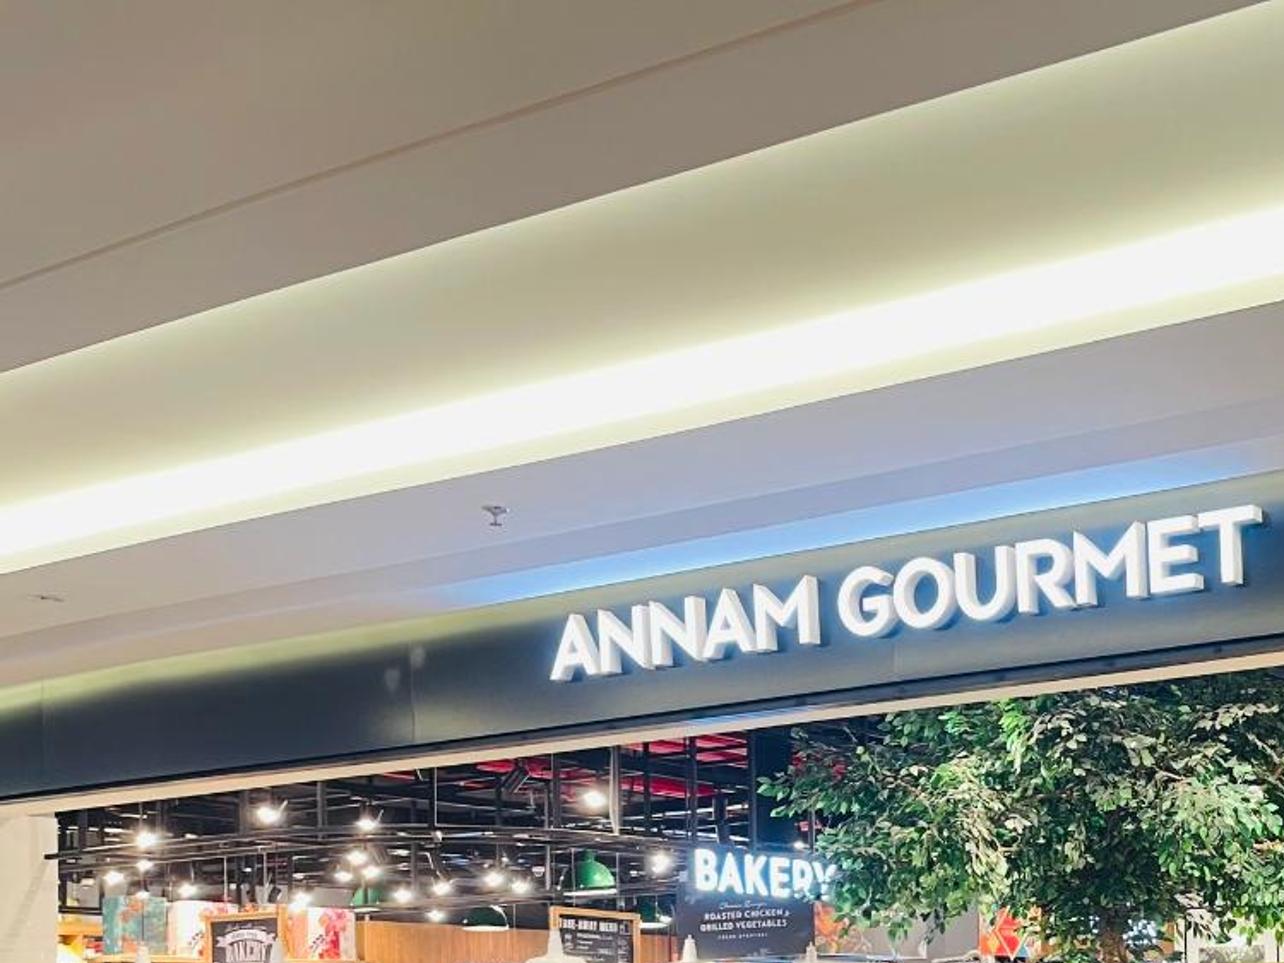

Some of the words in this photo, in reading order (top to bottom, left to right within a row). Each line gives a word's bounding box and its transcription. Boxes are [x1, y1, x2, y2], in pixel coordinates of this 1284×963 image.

[549, 573, 823, 683] ANNAM
[838, 503, 1264, 639] GOURMET
[693, 847, 838, 901] BAKERY
